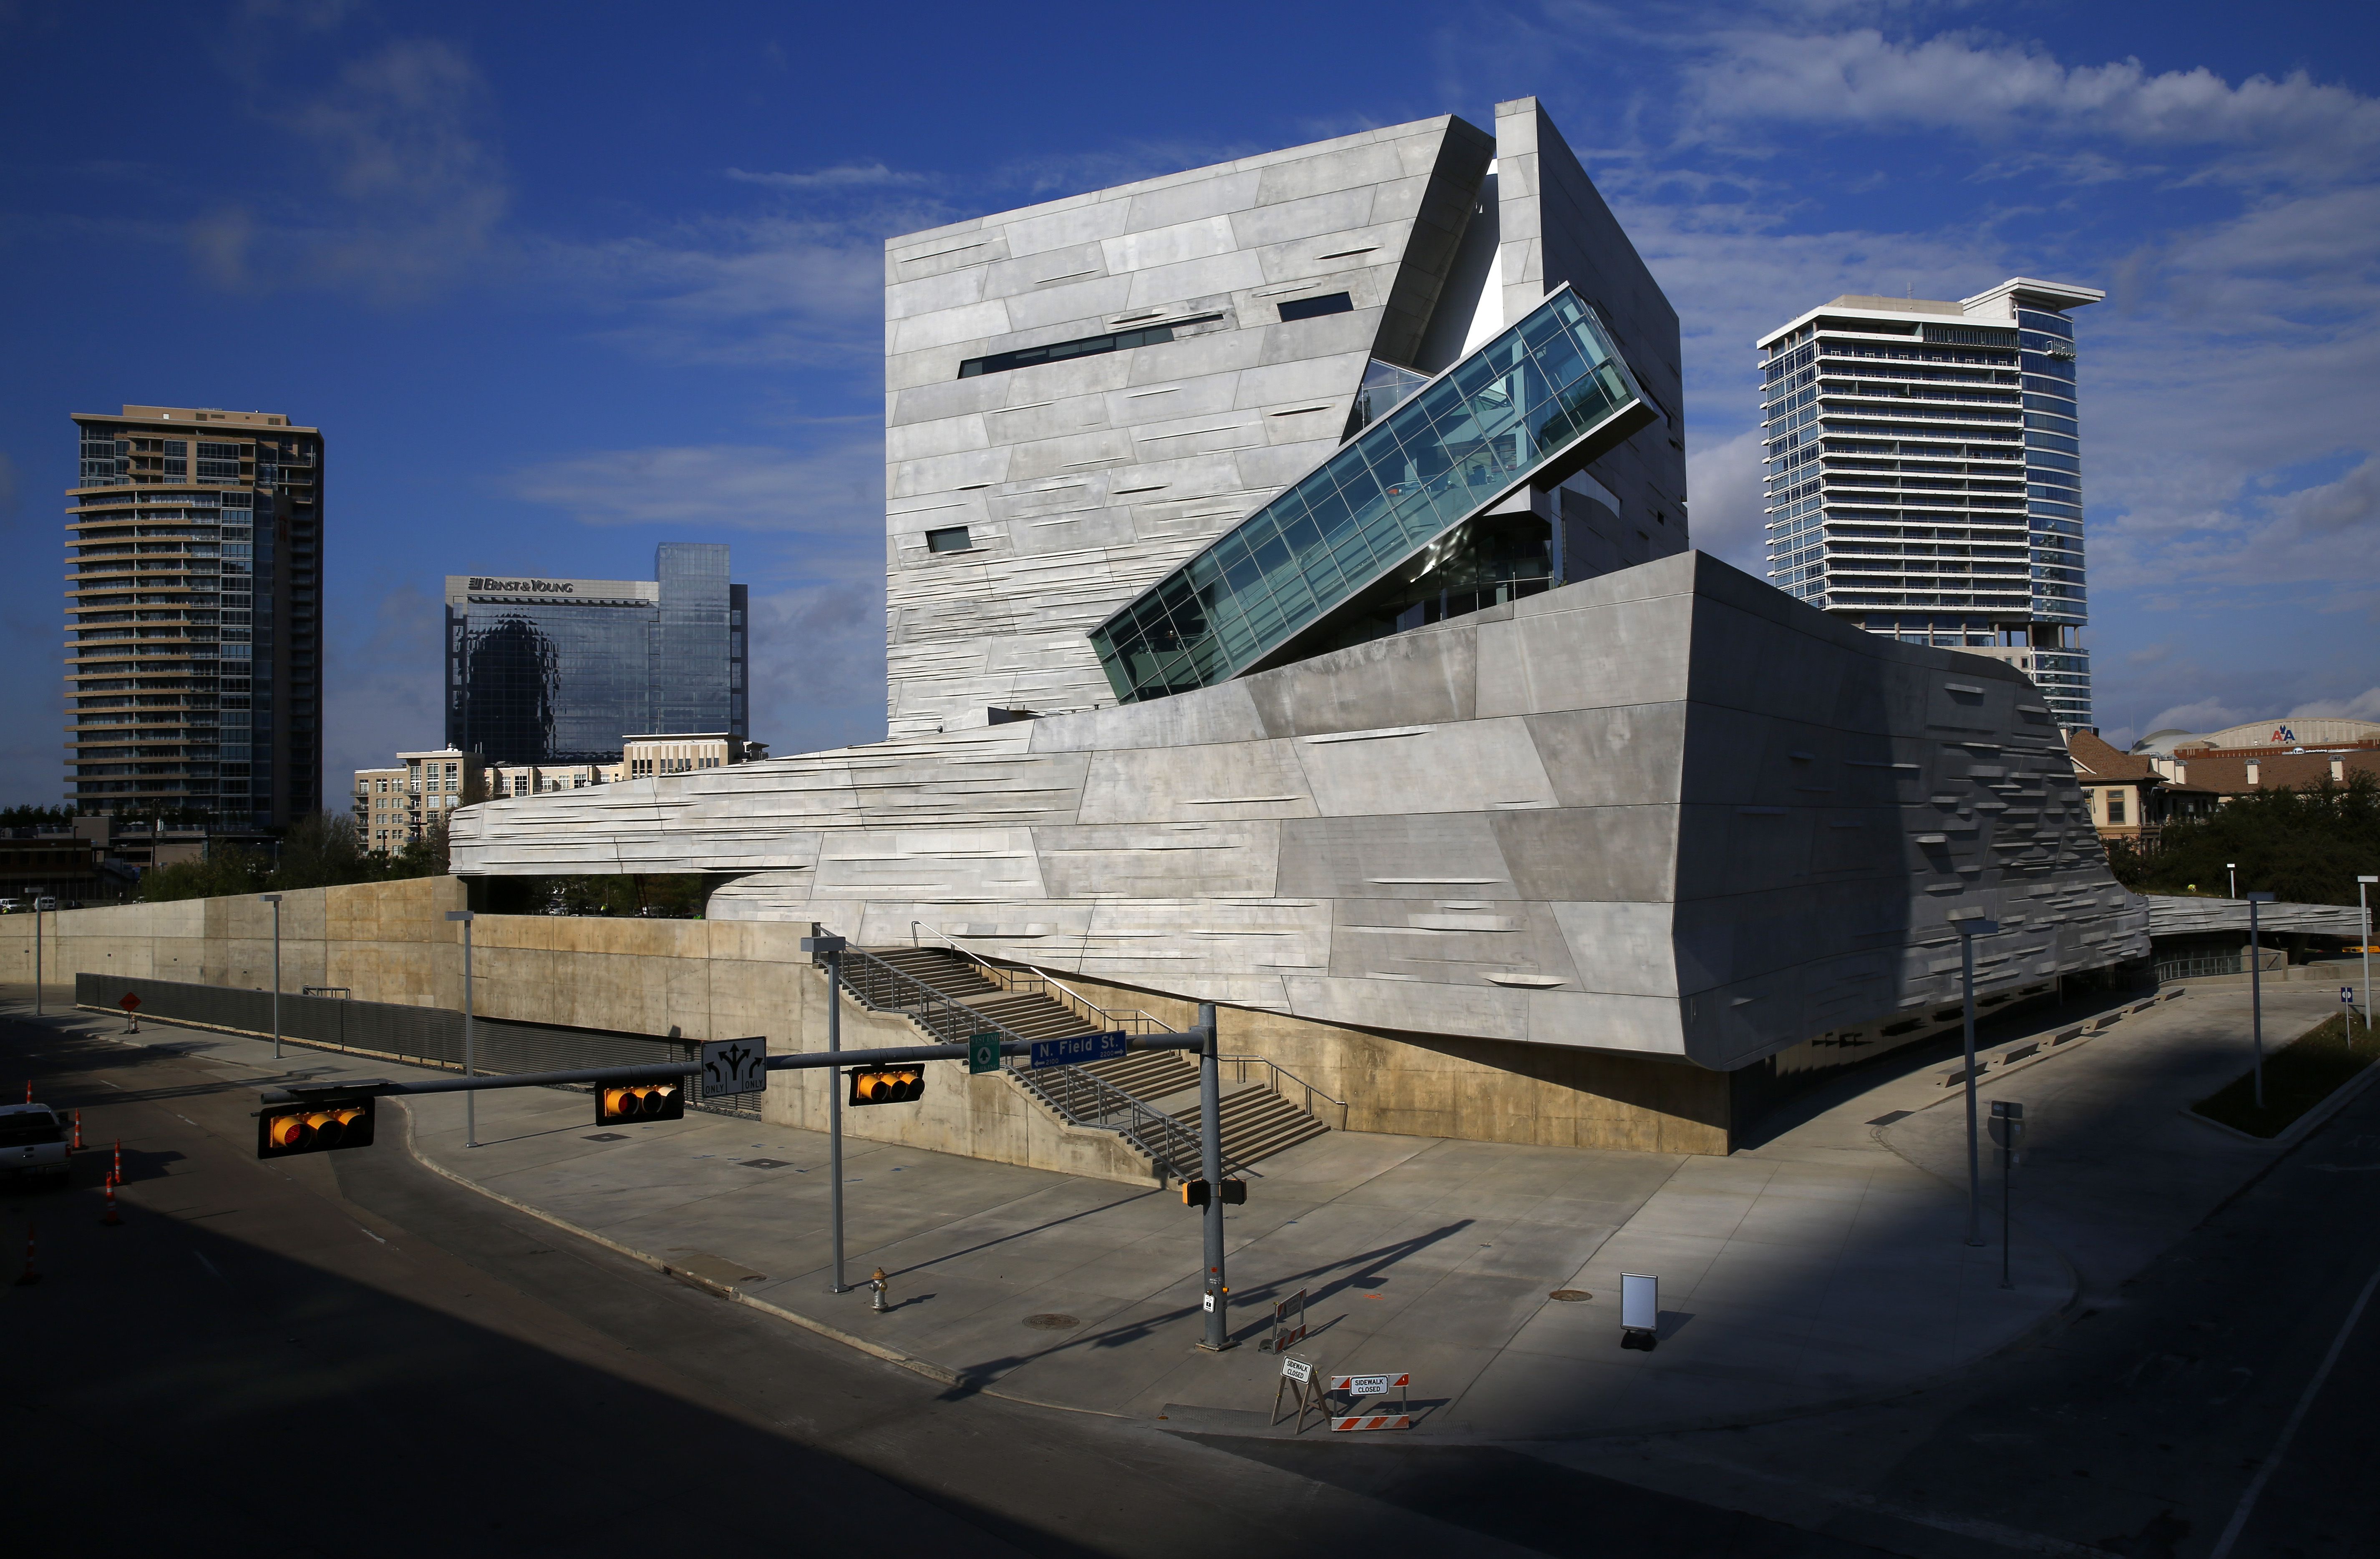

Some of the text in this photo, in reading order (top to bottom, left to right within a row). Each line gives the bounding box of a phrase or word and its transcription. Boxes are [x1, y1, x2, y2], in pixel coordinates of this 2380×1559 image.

[484, 578, 573, 593] ERNST & YOUNG
[1040, 1035, 1118, 1057] N. Field St.
[973, 1064, 997, 1072] PARKING
[705, 1084, 724, 1094] ONLY
[745, 1079, 763, 1089] ONLY
[1287, 1360, 1308, 1372] SIDEWALK
[1287, 1368, 1304, 1379] CLOSED
